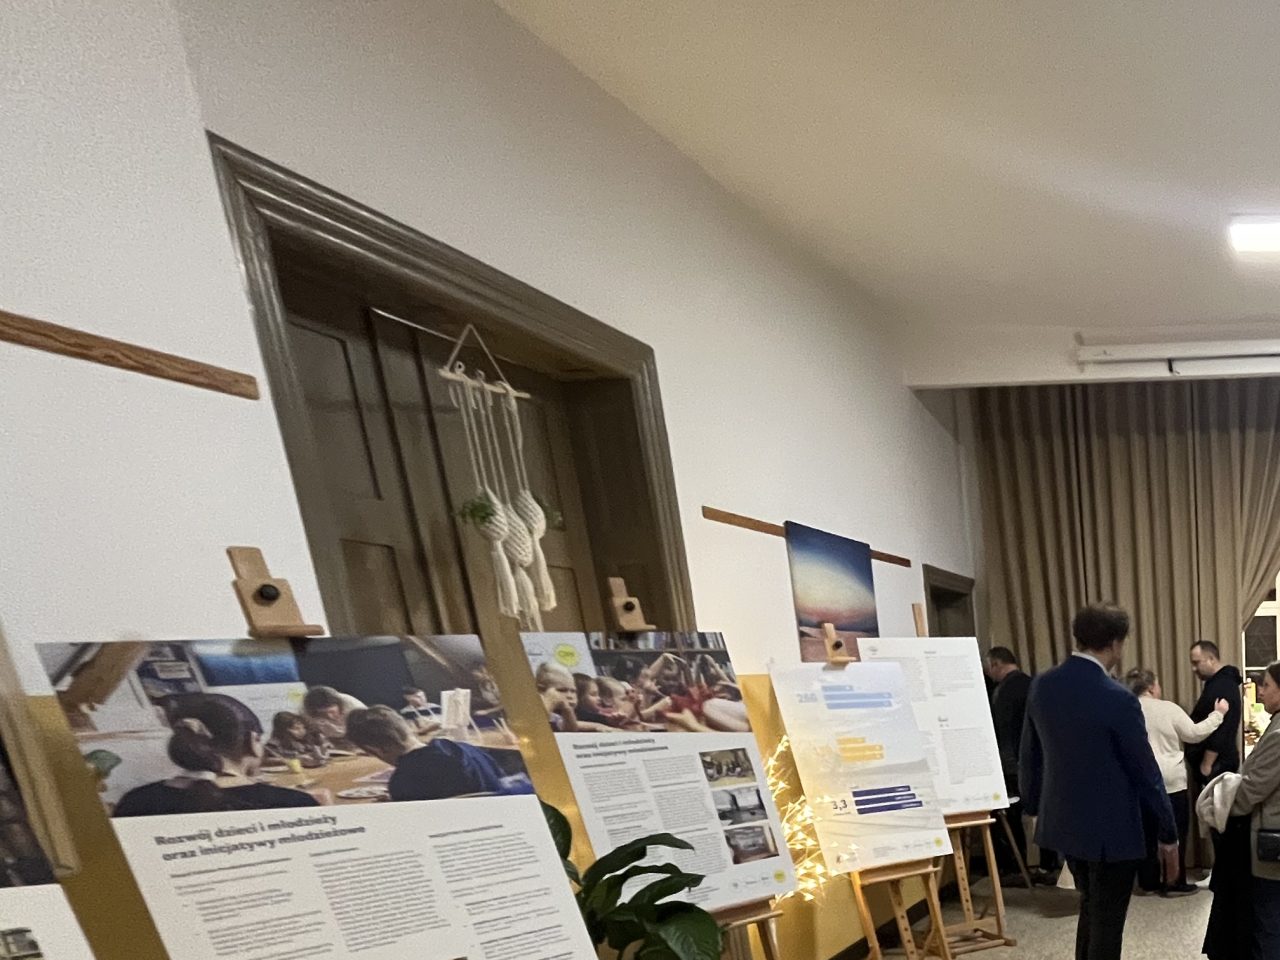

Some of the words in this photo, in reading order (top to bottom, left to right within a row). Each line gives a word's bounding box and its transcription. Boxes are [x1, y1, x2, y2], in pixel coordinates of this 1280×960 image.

[154, 829, 213, 846] Rozwój
[215, 824, 258, 838] dzieci
[267, 814, 337, 831] młodzieży
[162, 849, 197, 861] oraz
[199, 838, 276, 856] inicjatywy
